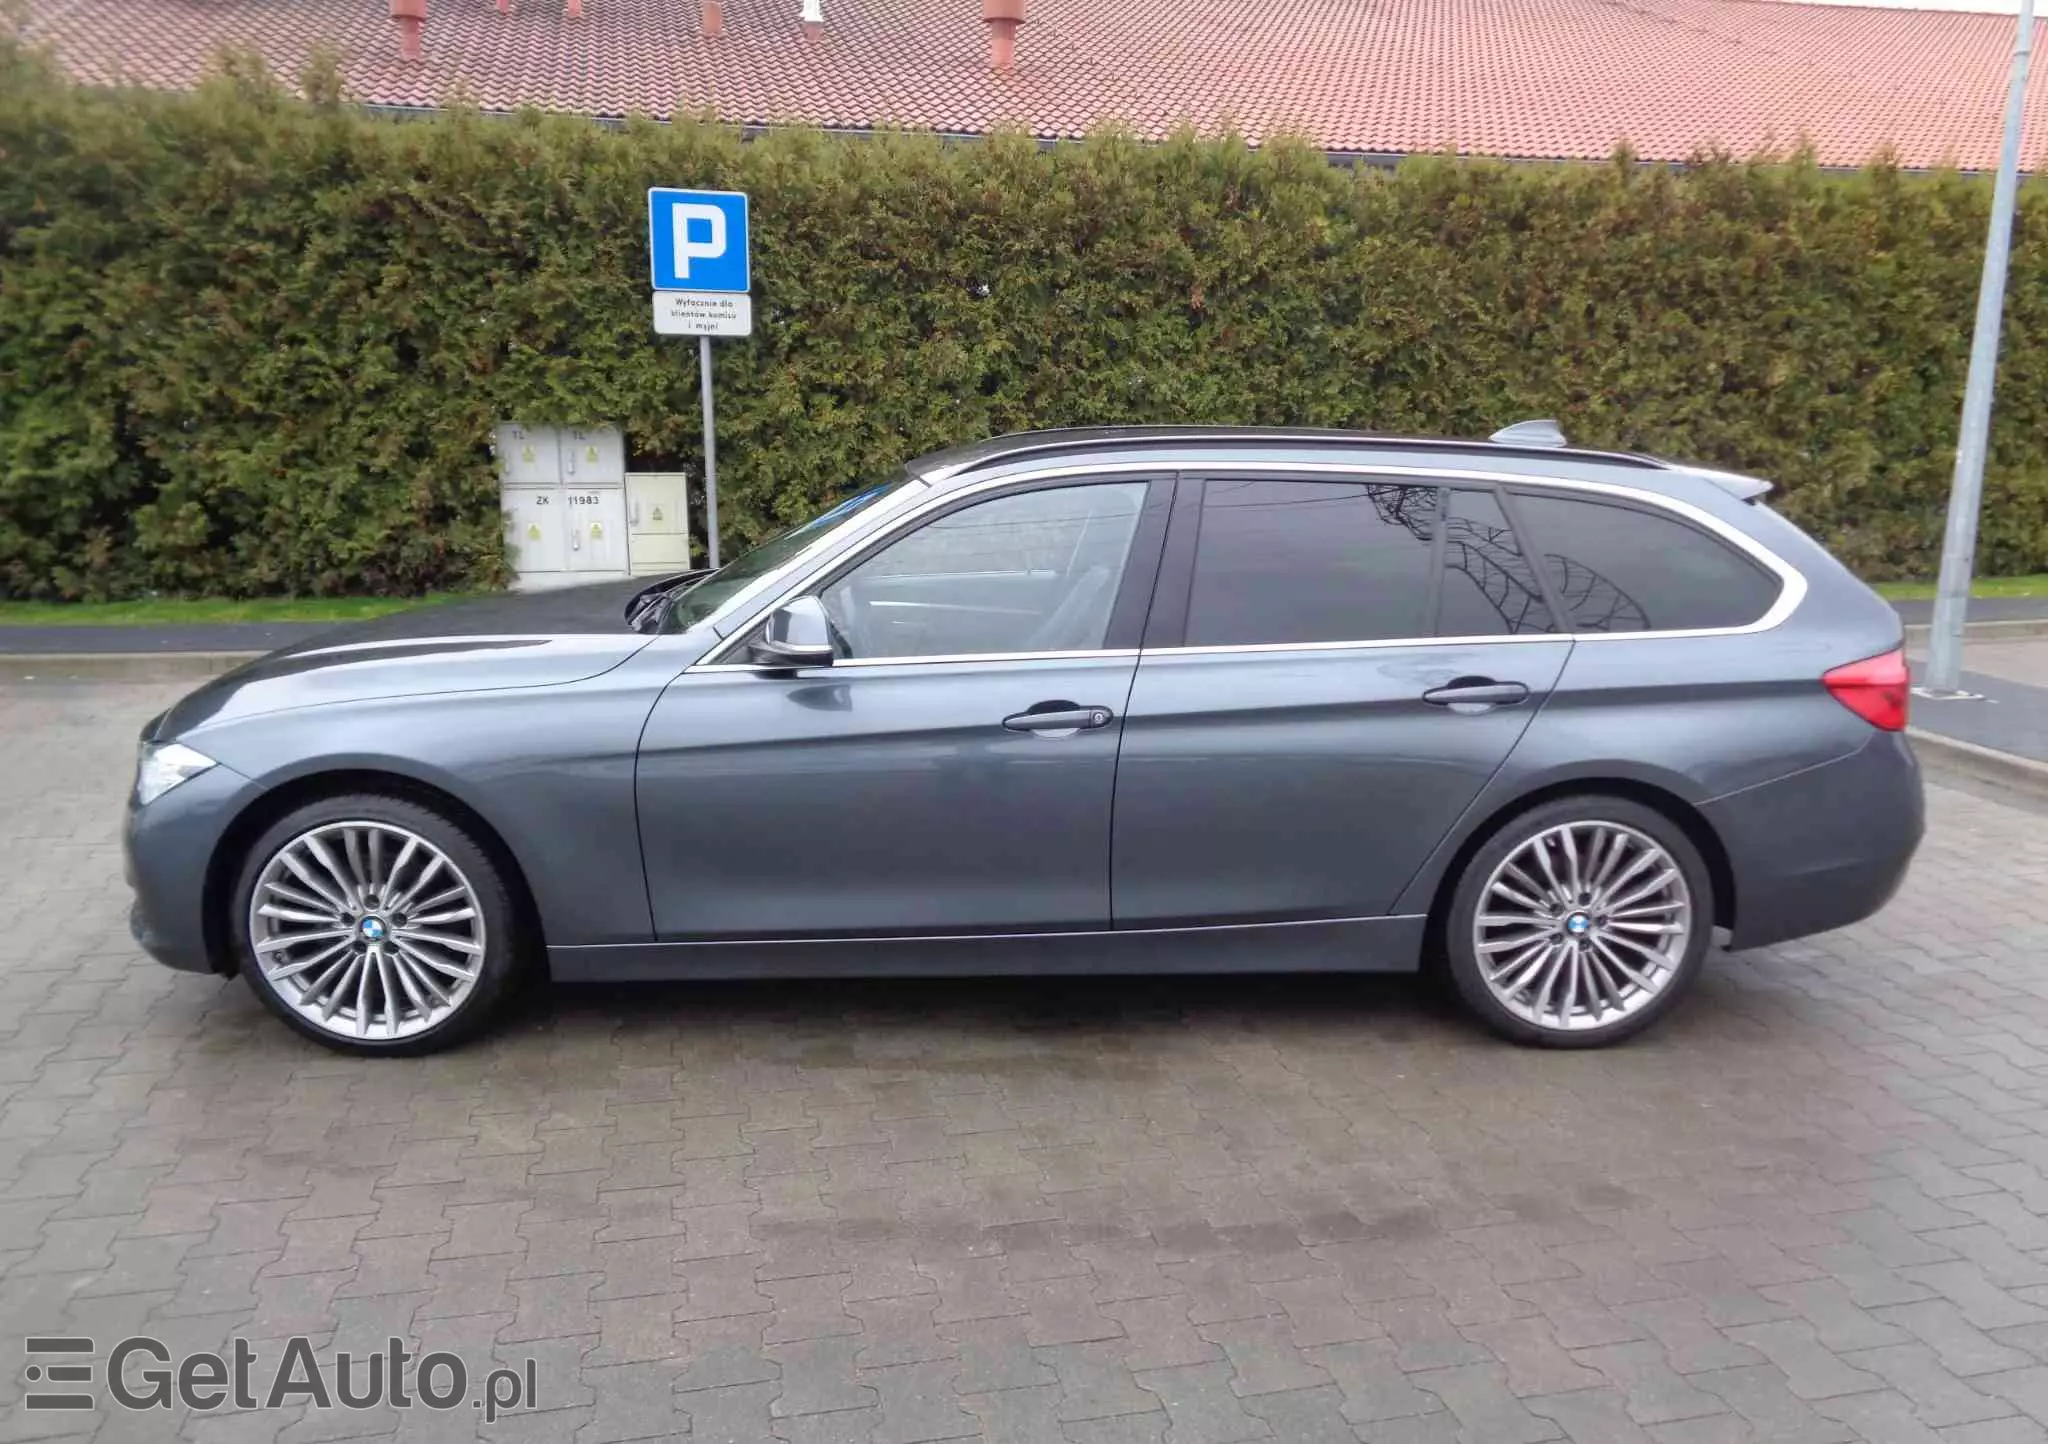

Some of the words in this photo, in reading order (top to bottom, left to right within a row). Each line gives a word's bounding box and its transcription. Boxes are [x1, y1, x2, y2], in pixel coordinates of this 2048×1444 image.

[672, 203, 726, 279] P
[719, 298, 734, 307] dla
[567, 496, 600, 505] 11983
